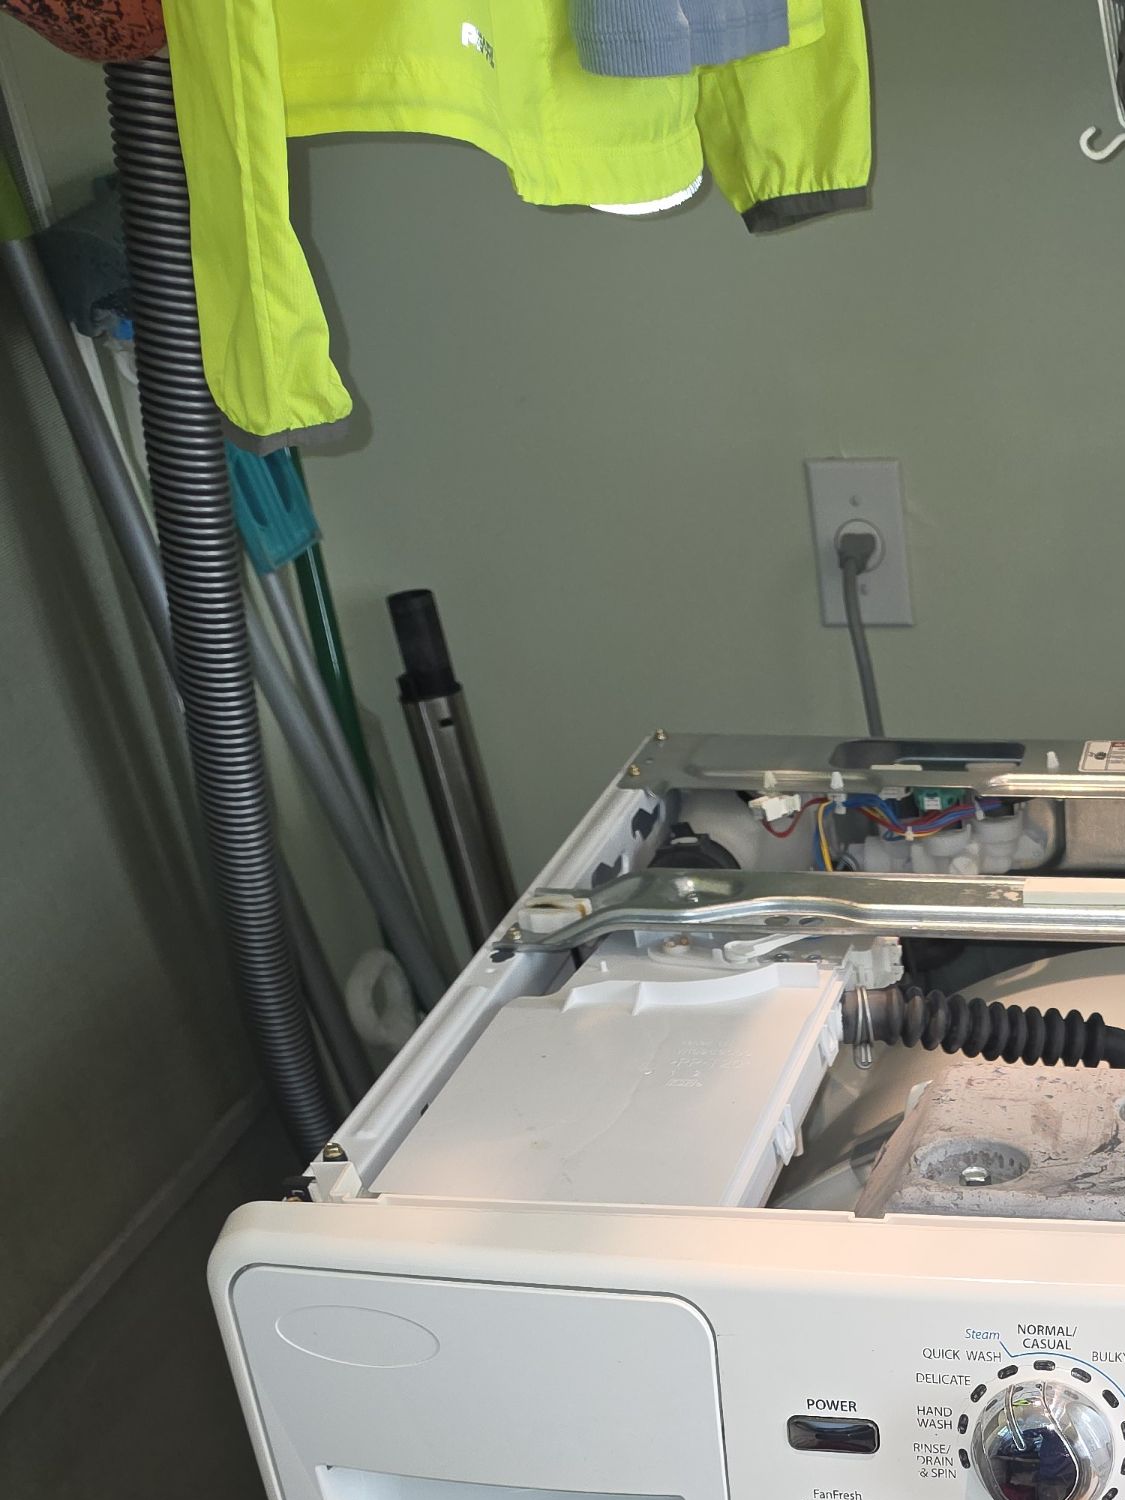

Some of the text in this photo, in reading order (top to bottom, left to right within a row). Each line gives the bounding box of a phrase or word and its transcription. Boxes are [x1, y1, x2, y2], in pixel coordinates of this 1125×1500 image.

[965, 1328, 1000, 1340] Steam
[1017, 1324, 1077, 1337] NORMAL/
[1022, 1338, 1072, 1350] CASUAL
[922, 1348, 1002, 1362] QUICK WASH
[916, 1373, 971, 1386] DELICATE
[806, 1398, 857, 1412] POWER
[917, 1406, 952, 1417] HAND
[917, 1418, 952, 1430] WASH
[920, 1468, 957, 1479] & SPIN
[813, 1489, 862, 1500] FanFresh
